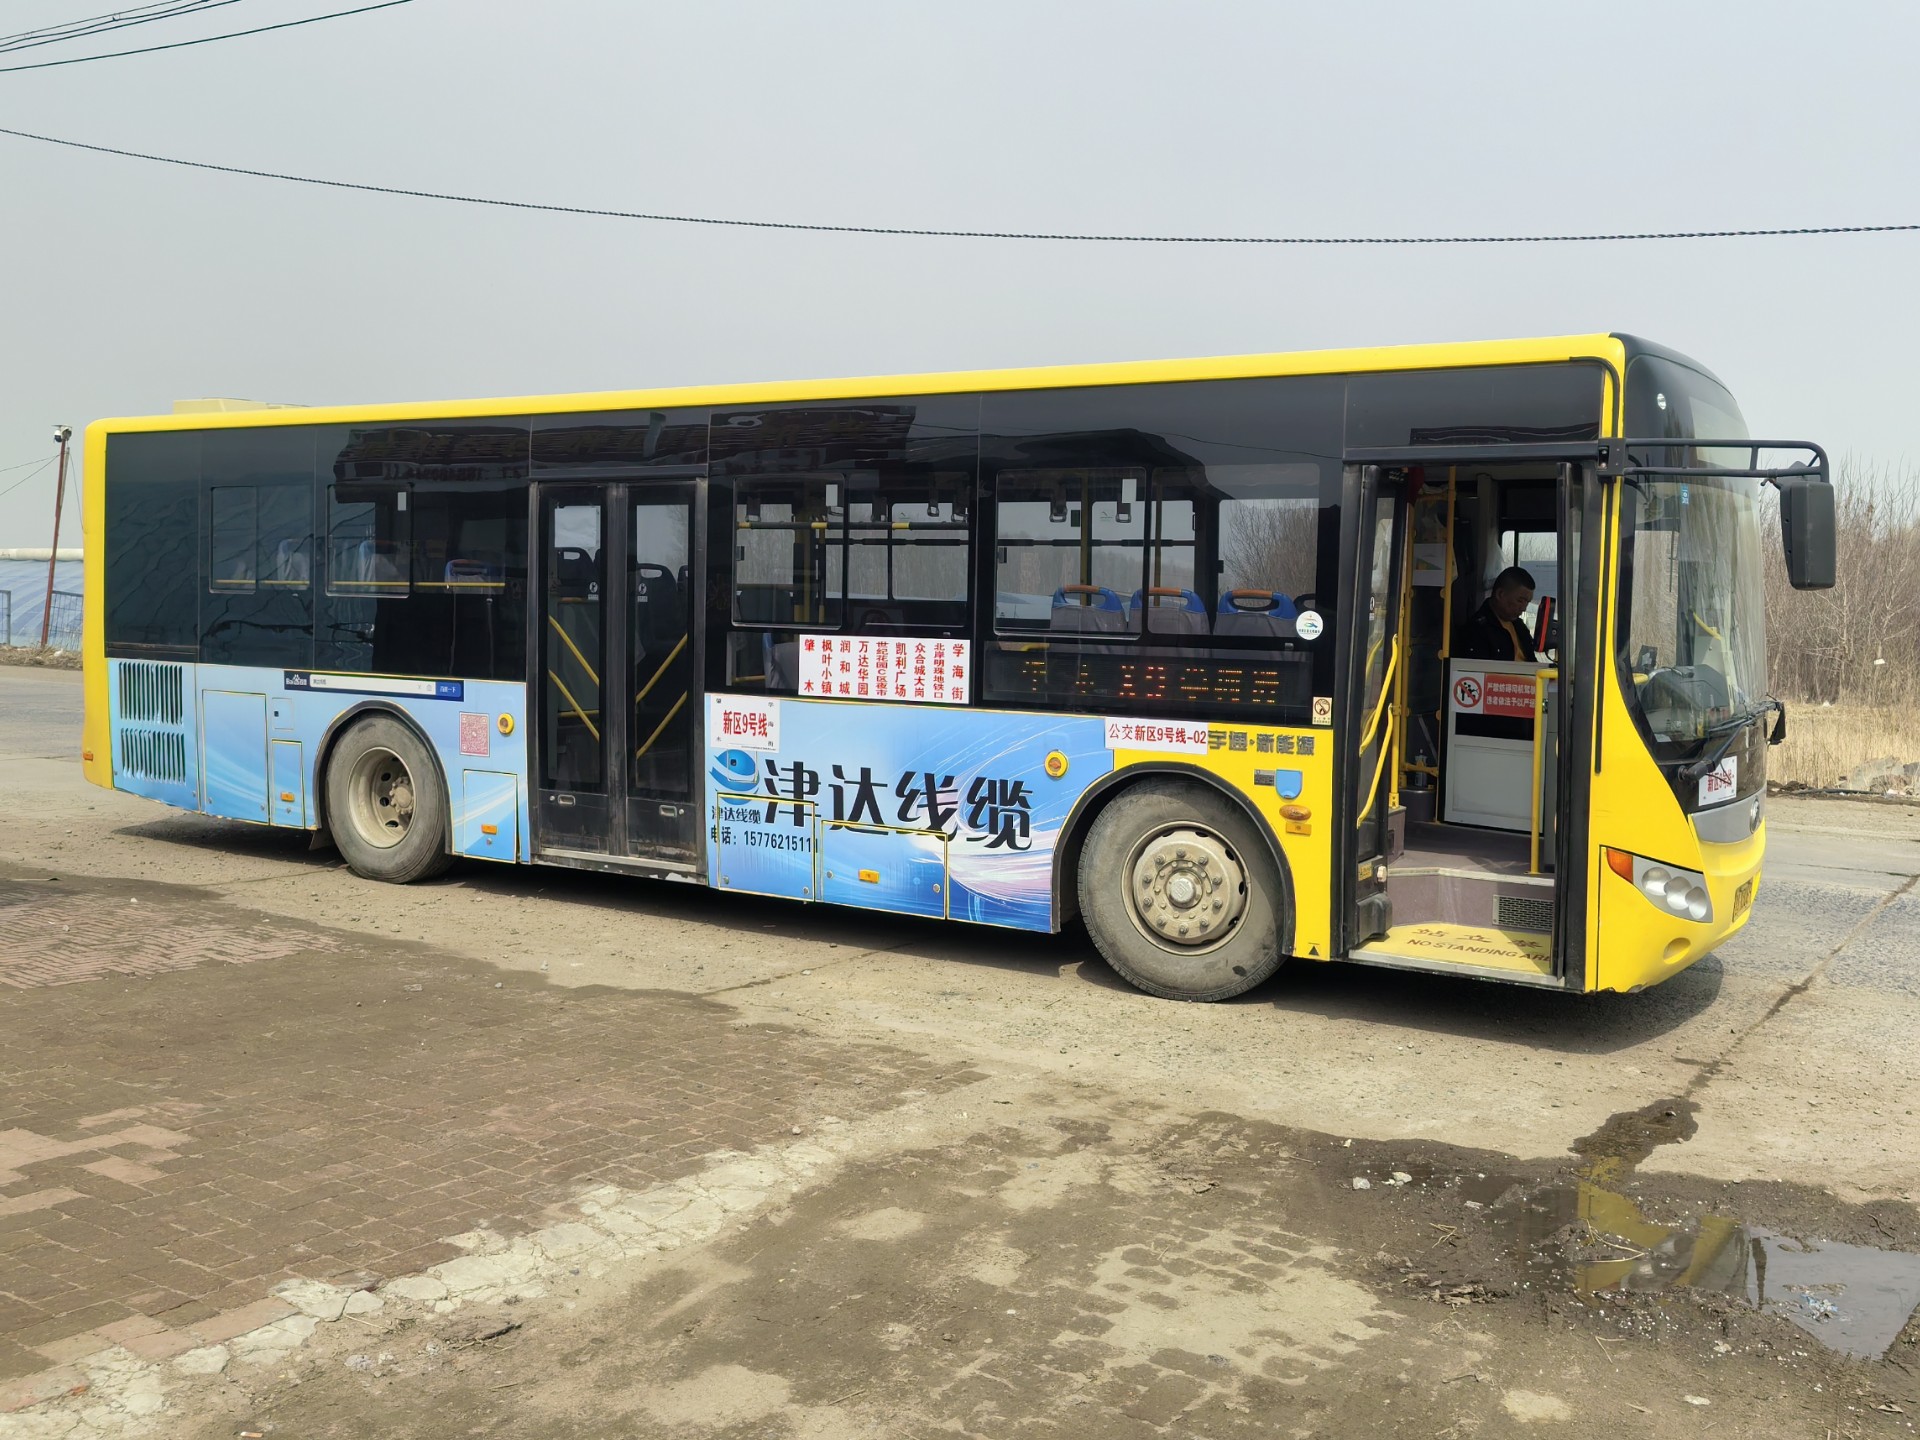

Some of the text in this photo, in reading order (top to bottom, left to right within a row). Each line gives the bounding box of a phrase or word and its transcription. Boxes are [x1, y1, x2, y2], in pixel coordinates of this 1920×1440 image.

[821, 639, 833, 695] 枫叶小镇
[838, 640, 851, 695] 润和城
[857, 641, 869, 696] 万达华园
[875, 641, 889, 697] 世纪花园C区夜市
[894, 642, 907, 698] 凯利广场
[914, 643, 926, 699] 众合城大岗
[933, 643, 945, 699] 北岸明珠地铁口
[951, 643, 964, 700] 学海街
[723, 710, 768, 738] 新区9号线
[1109, 723, 1207, 745] 公交新区9号线-02
[711, 805, 761, 825] 津达线缆
[764, 758, 1033, 851] 津达线缆
[1407, 938, 1430, 946] NO
[1433, 941, 1517, 957] STANDING
